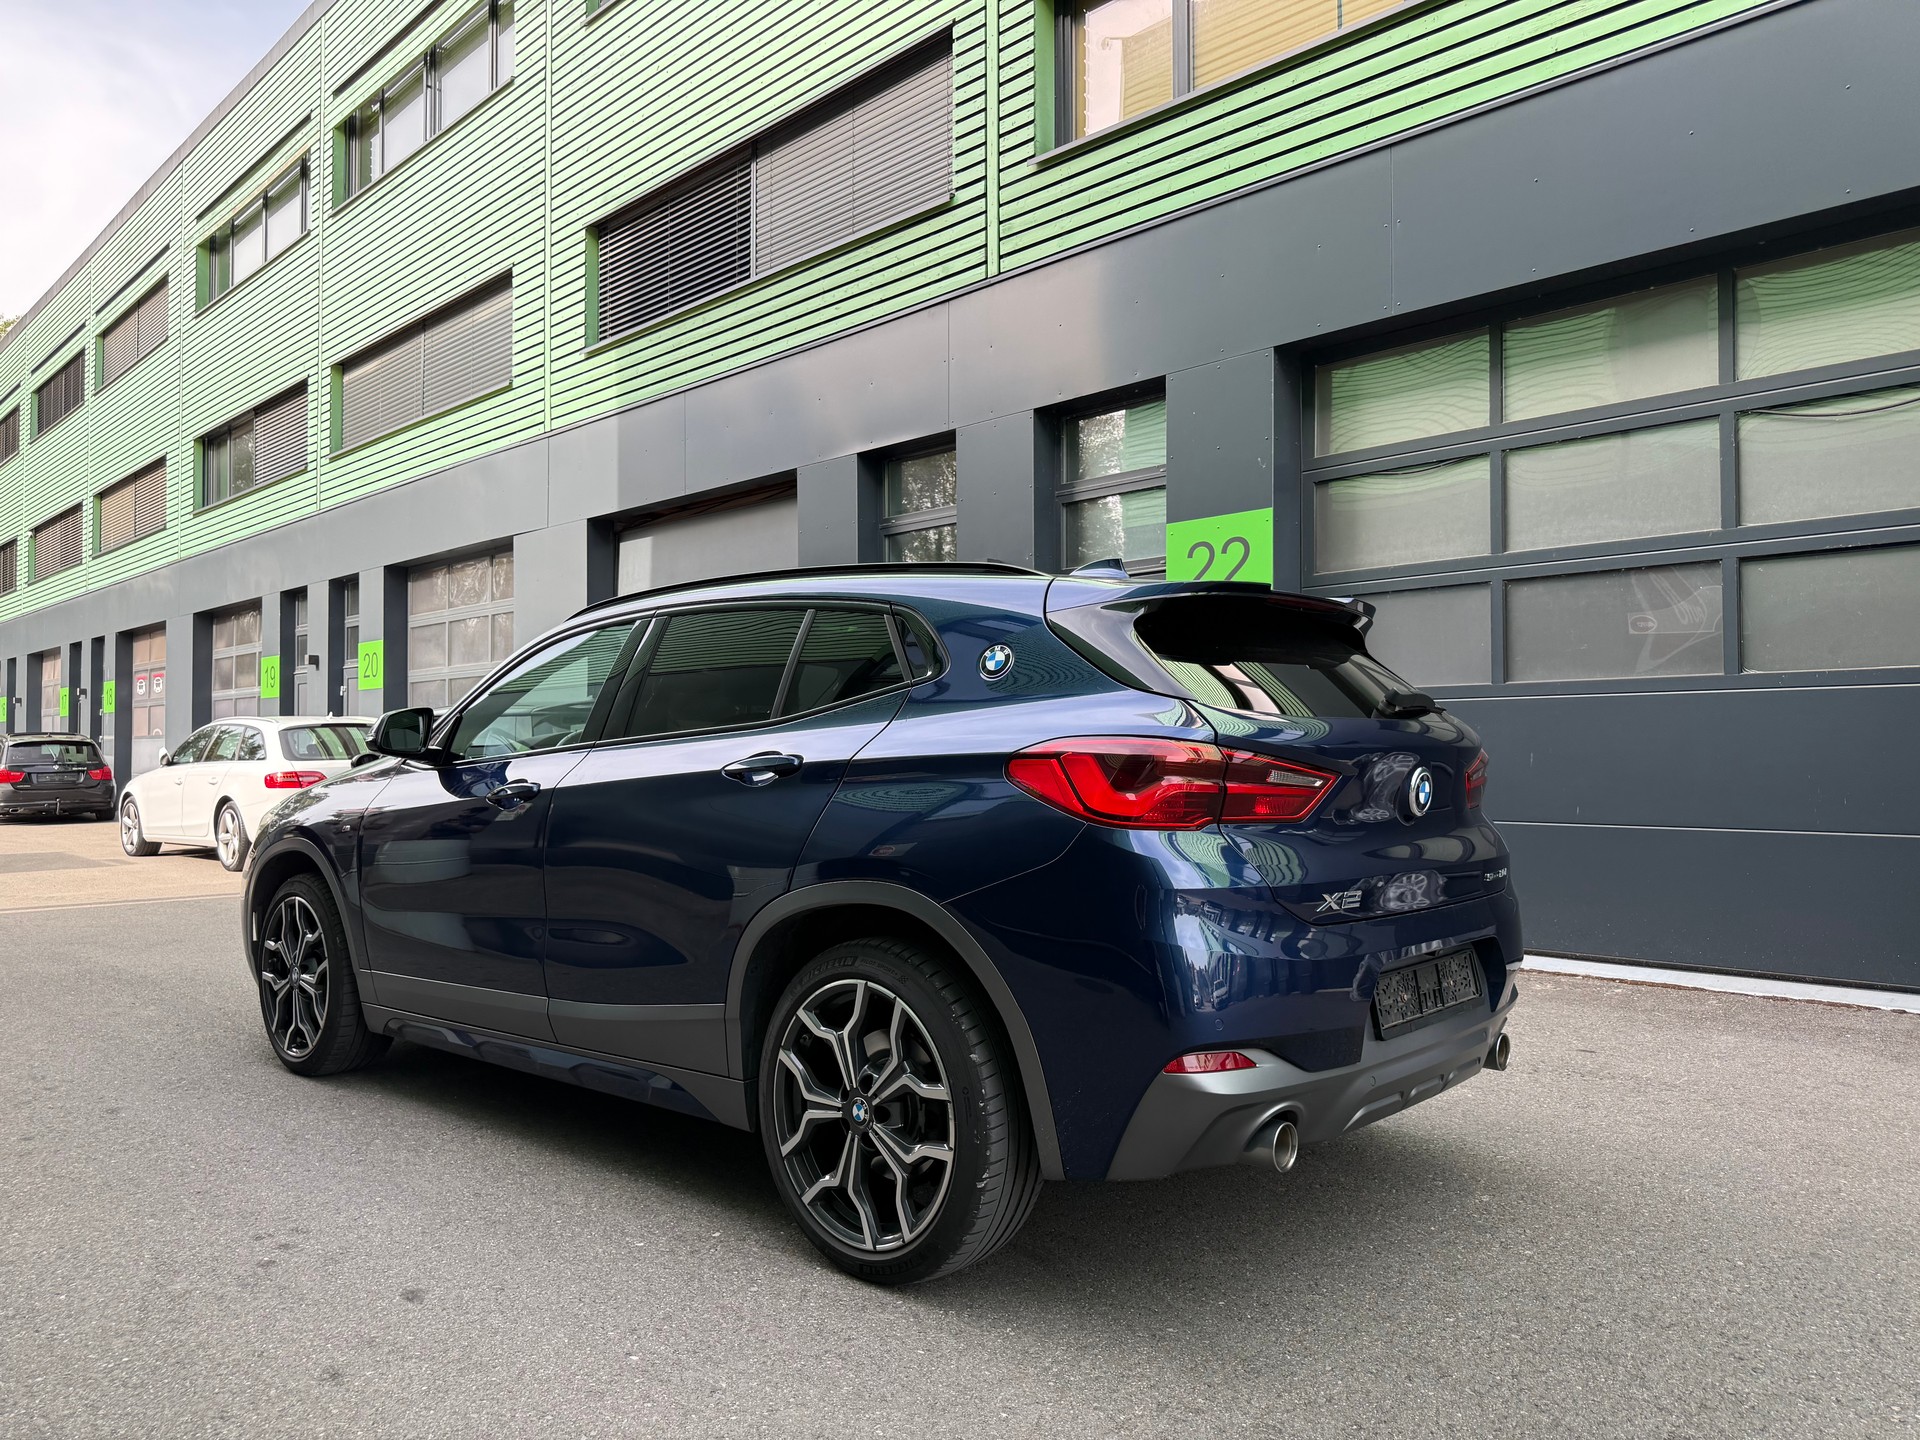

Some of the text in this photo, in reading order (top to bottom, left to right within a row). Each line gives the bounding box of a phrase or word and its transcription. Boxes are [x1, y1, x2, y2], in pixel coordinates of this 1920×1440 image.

[1186, 536, 1251, 581] 22
[264, 665, 276, 689] 19
[363, 651, 379, 679] 20
[106, 688, 113, 706] 18
[1316, 890, 1362, 912] X2
